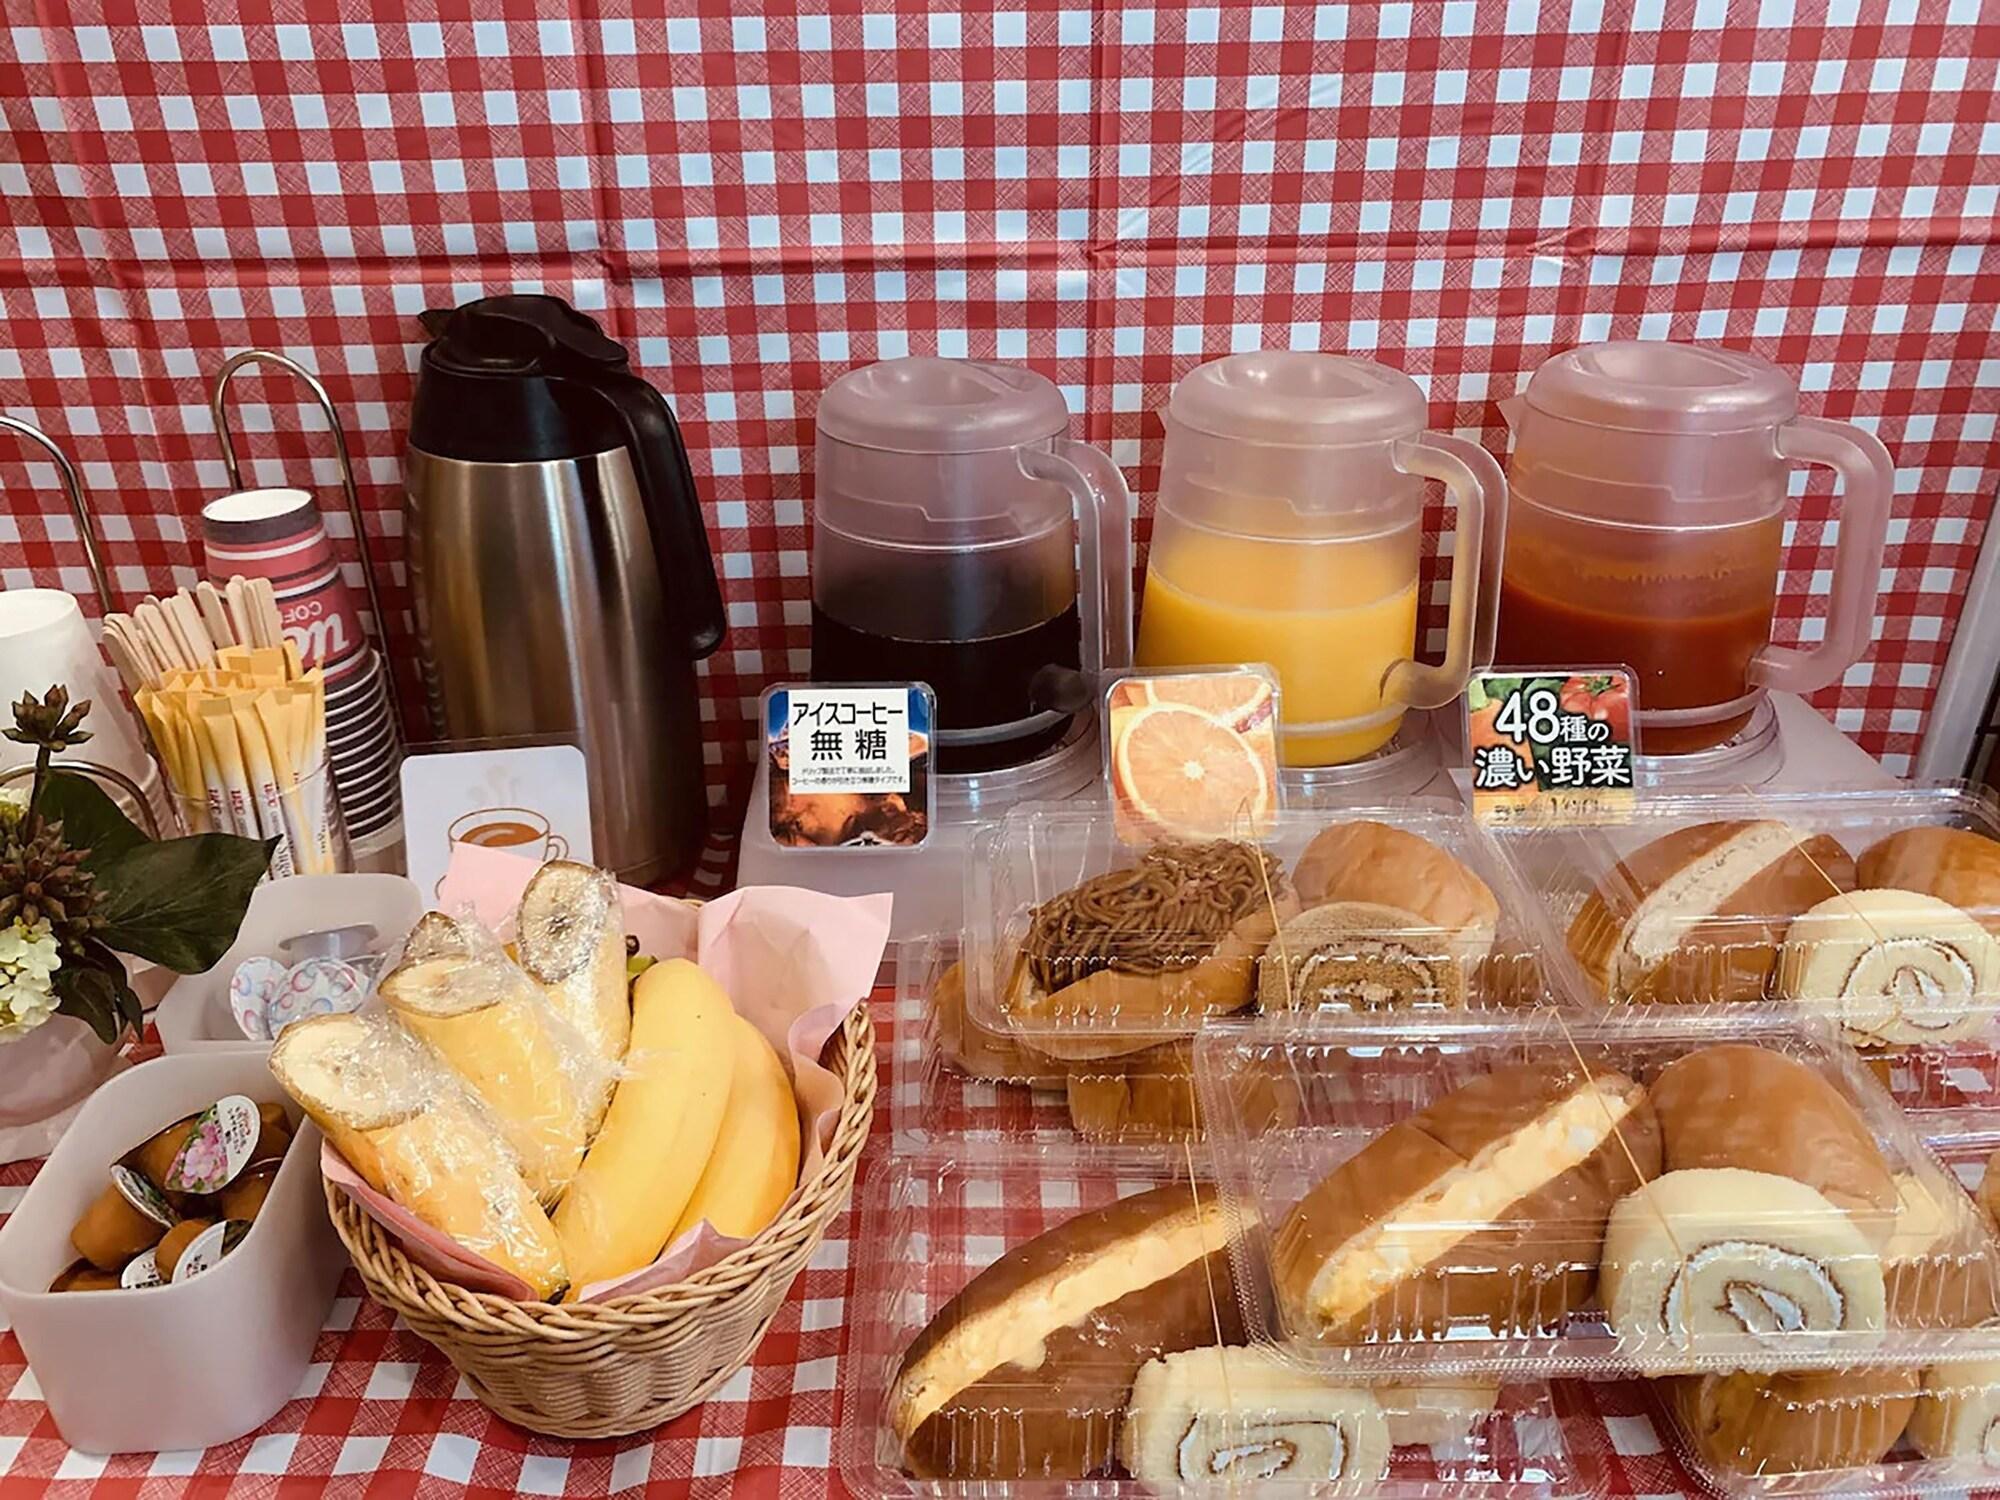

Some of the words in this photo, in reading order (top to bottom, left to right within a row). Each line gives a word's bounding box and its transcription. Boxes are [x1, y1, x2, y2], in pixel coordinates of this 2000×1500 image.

[282, 601, 322, 624] COF
[793, 702, 903, 726] アイスコーヒー
[1495, 690, 1610, 743] 48種の
[1474, 745, 1631, 788] 濃い野菜
[275, 845, 292, 878] Suga
